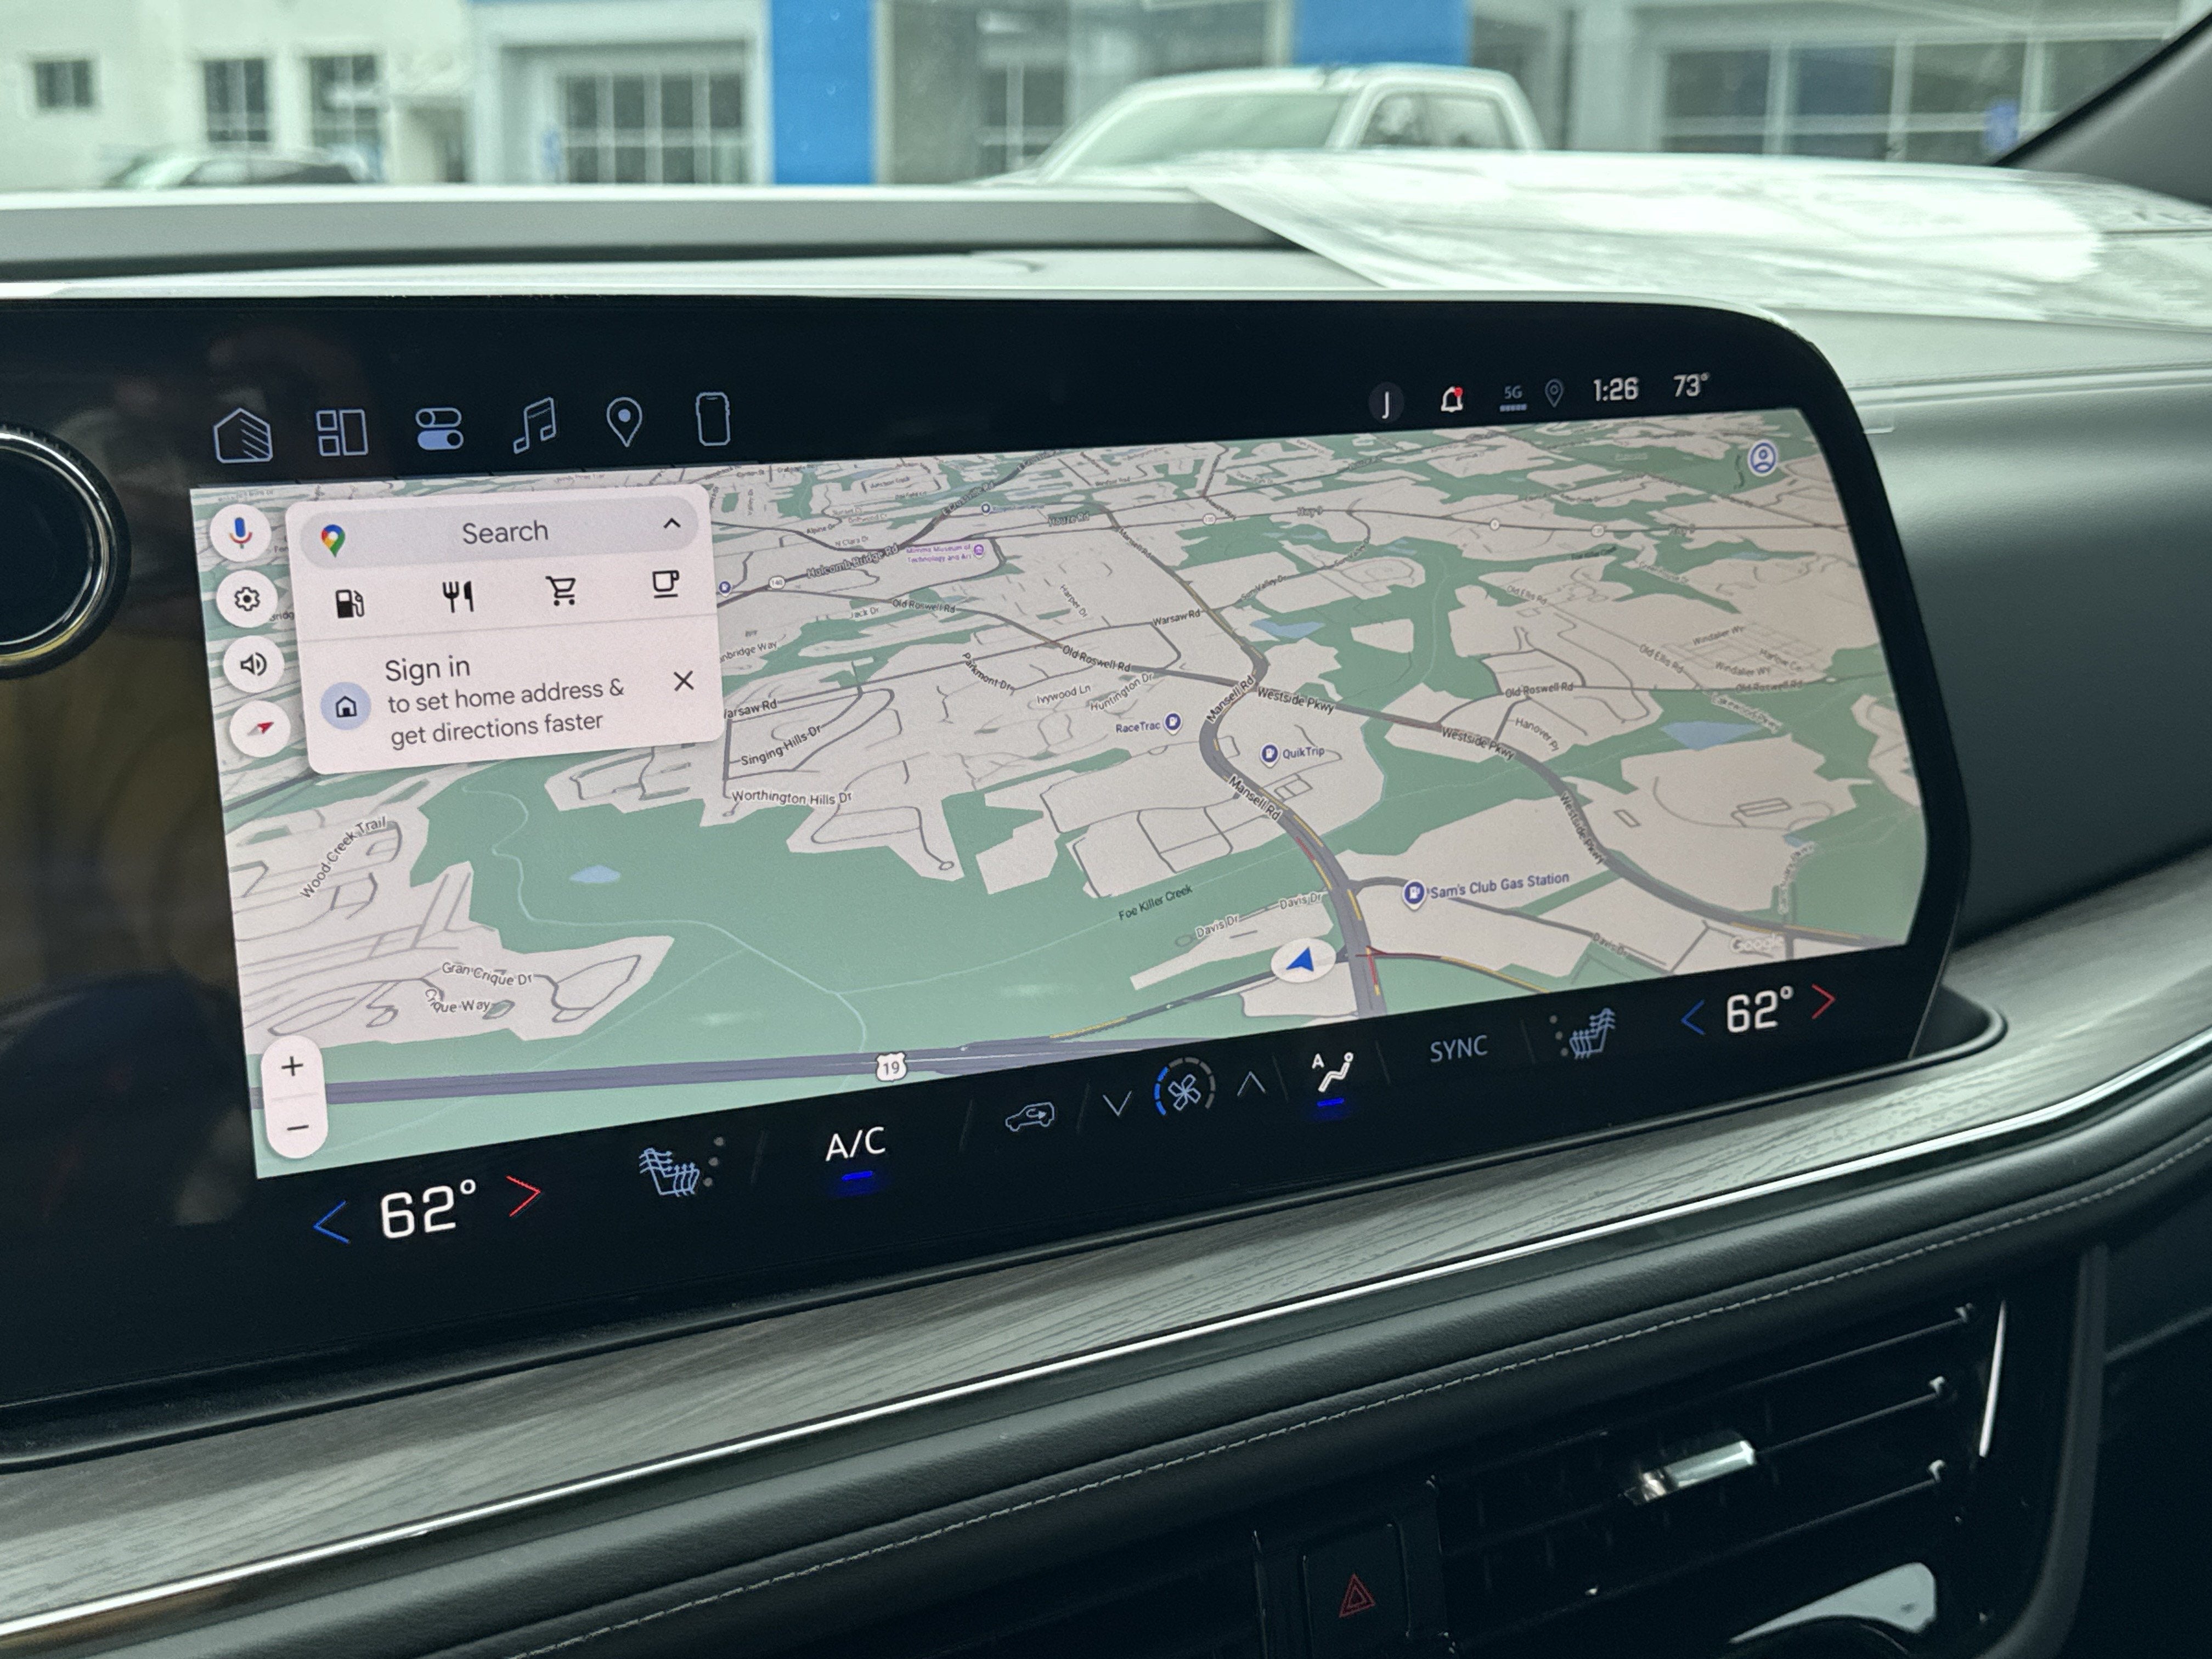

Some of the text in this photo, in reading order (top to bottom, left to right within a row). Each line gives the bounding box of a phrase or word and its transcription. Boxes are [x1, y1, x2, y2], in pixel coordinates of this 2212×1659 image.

[1504, 386, 1523, 399] 5G
[1593, 377, 1639, 402] 1:26
[1673, 372, 1710, 398] 73°
[462, 520, 548, 544] Search
[884, 543, 900, 556] Rd
[892, 599, 956, 613] Old Roswell Rd
[1060, 584, 1088, 618] Harper Dr
[1153, 609, 1200, 627] Warsaw Rd
[757, 641, 778, 651] Way
[1062, 645, 1131, 672] Old Roswell Rd
[385, 655, 471, 686] Sign in
[962, 652, 1011, 691] Parkmont Dr
[388, 678, 625, 714] to set home address &
[1037, 685, 1091, 705] Ivywood Ln
[1090, 673, 1153, 712] Huntington Dr
[1206, 674, 1255, 723] Mansell Rd
[1257, 686, 1335, 715] Westside Pkwy
[1505, 681, 1574, 698] Old Roswell Rd
[761, 698, 777, 712] Rd
[391, 713, 603, 751] get directions faster
[1515, 716, 1552, 742] Hanover
[741, 725, 821, 766] Singing Hills Dr
[1441, 726, 1515, 761] Westside Pkwy
[732, 790, 852, 806] Worthington Hills Dr
[1228, 776, 1282, 821] Mansell Rd
[300, 816, 386, 898] Wood Creek Trail
[1430, 873, 1570, 899] Sam's Club Gas Station
[1118, 884, 1193, 921] Foe Killer Creek
[1279, 892, 1322, 910] Davis Dr
[1196, 914, 1239, 938] Davis Dr
[442, 962, 470, 975] Gran
[518, 973, 532, 986] Dr
[461, 1000, 491, 1013] Way
[1726, 985, 1794, 1034] 62°
[1430, 1034, 1488, 1063] SYNC
[883, 1060, 900, 1076] 19
[825, 1125, 887, 1162] A/C
[380, 1178, 476, 1240] 62°
